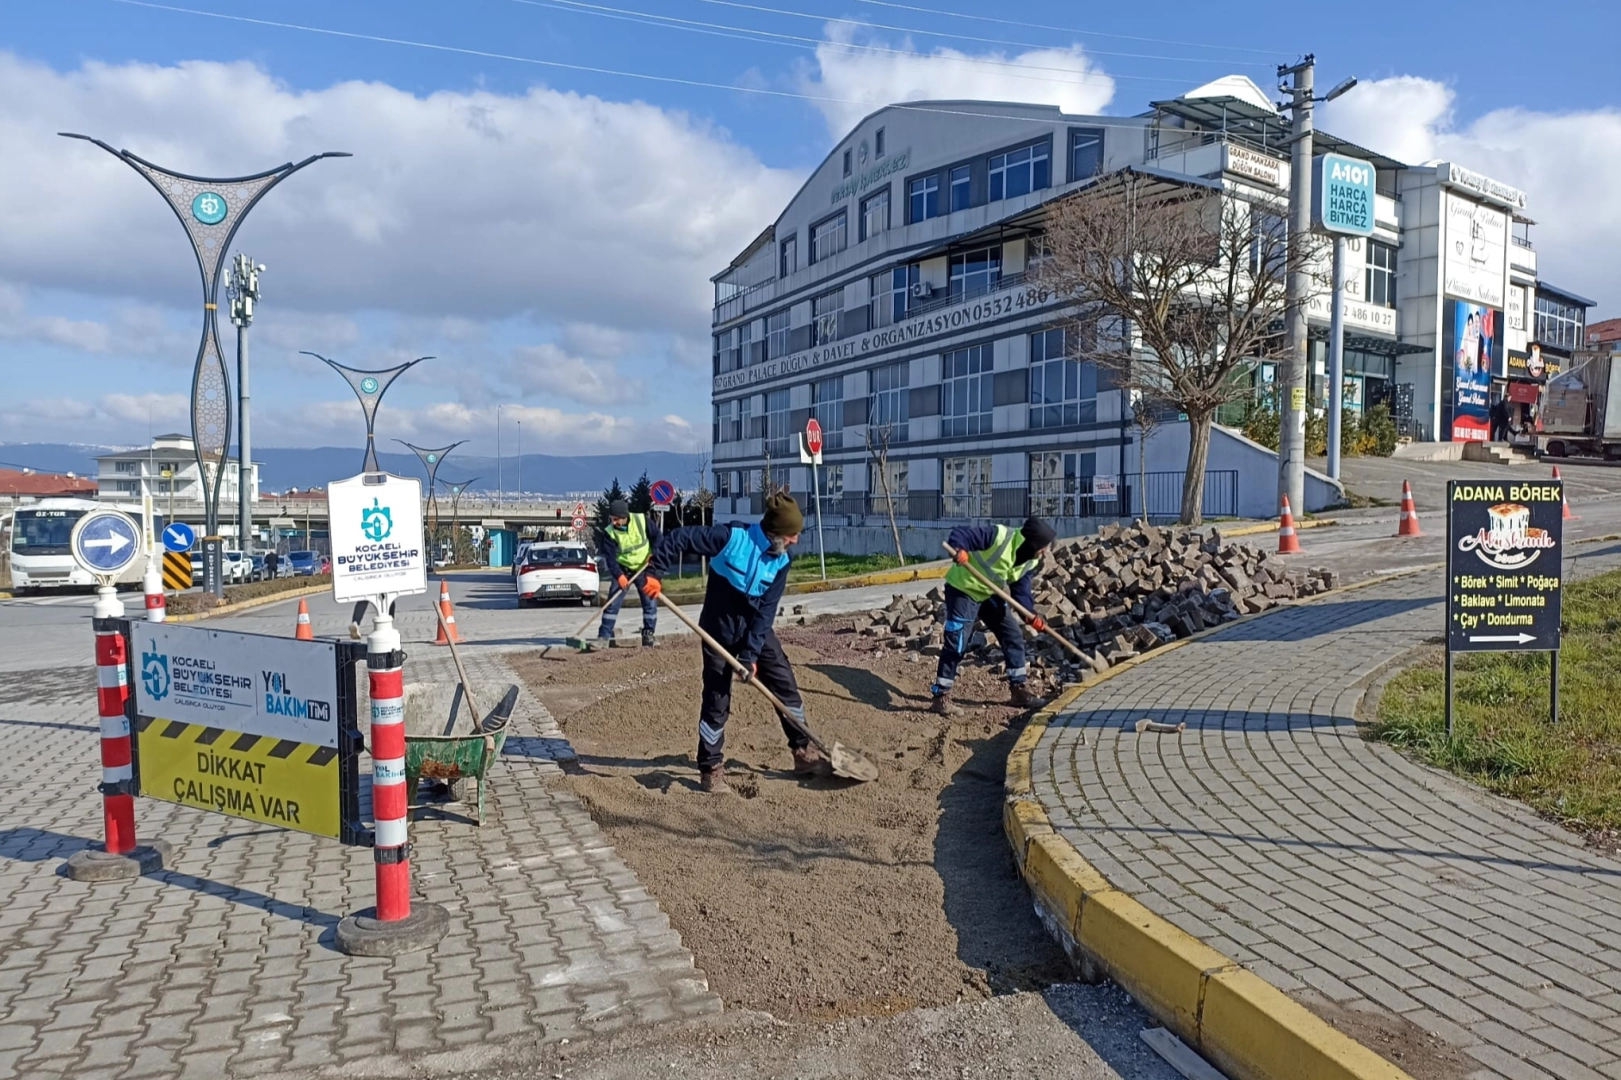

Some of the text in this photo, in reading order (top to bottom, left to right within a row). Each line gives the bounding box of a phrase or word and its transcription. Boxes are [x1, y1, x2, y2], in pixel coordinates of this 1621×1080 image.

[1330, 184, 1368, 203] HARCA
[1330, 197, 1367, 216] HARCA
[1352, 307, 1368, 321] 486
[1371, 311, 1380, 323] 10
[1382, 313, 1392, 325] 27
[722, 372, 745, 388] GRAND
[749, 363, 777, 382] PALACE
[780, 352, 808, 373] DÜĞÜN
[812, 351, 821, 365] &
[823, 341, 856, 361] DAVET
[861, 339, 871, 351] &
[873, 307, 972, 349] ORGANİZASYON
[973, 299, 1012, 321] 0532
[1015, 286, 1048, 310] 486
[1509, 356, 1526, 369] ADANA
[808, 429, 820, 443] DUR
[1453, 483, 1560, 502] ADANA BÖREK
[574, 519, 583, 527] 30
[1461, 575, 1559, 591] Börek Simit Poğaça
[1461, 594, 1545, 607] Baklava Limonata
[1460, 612, 1533, 629] Çay Dondurma
[261, 669, 291, 695] YOL
[265, 692, 308, 720] BAKIM
[197, 749, 266, 785] DİKKAT
[173, 777, 301, 824] ÇALIŞMA VAR
